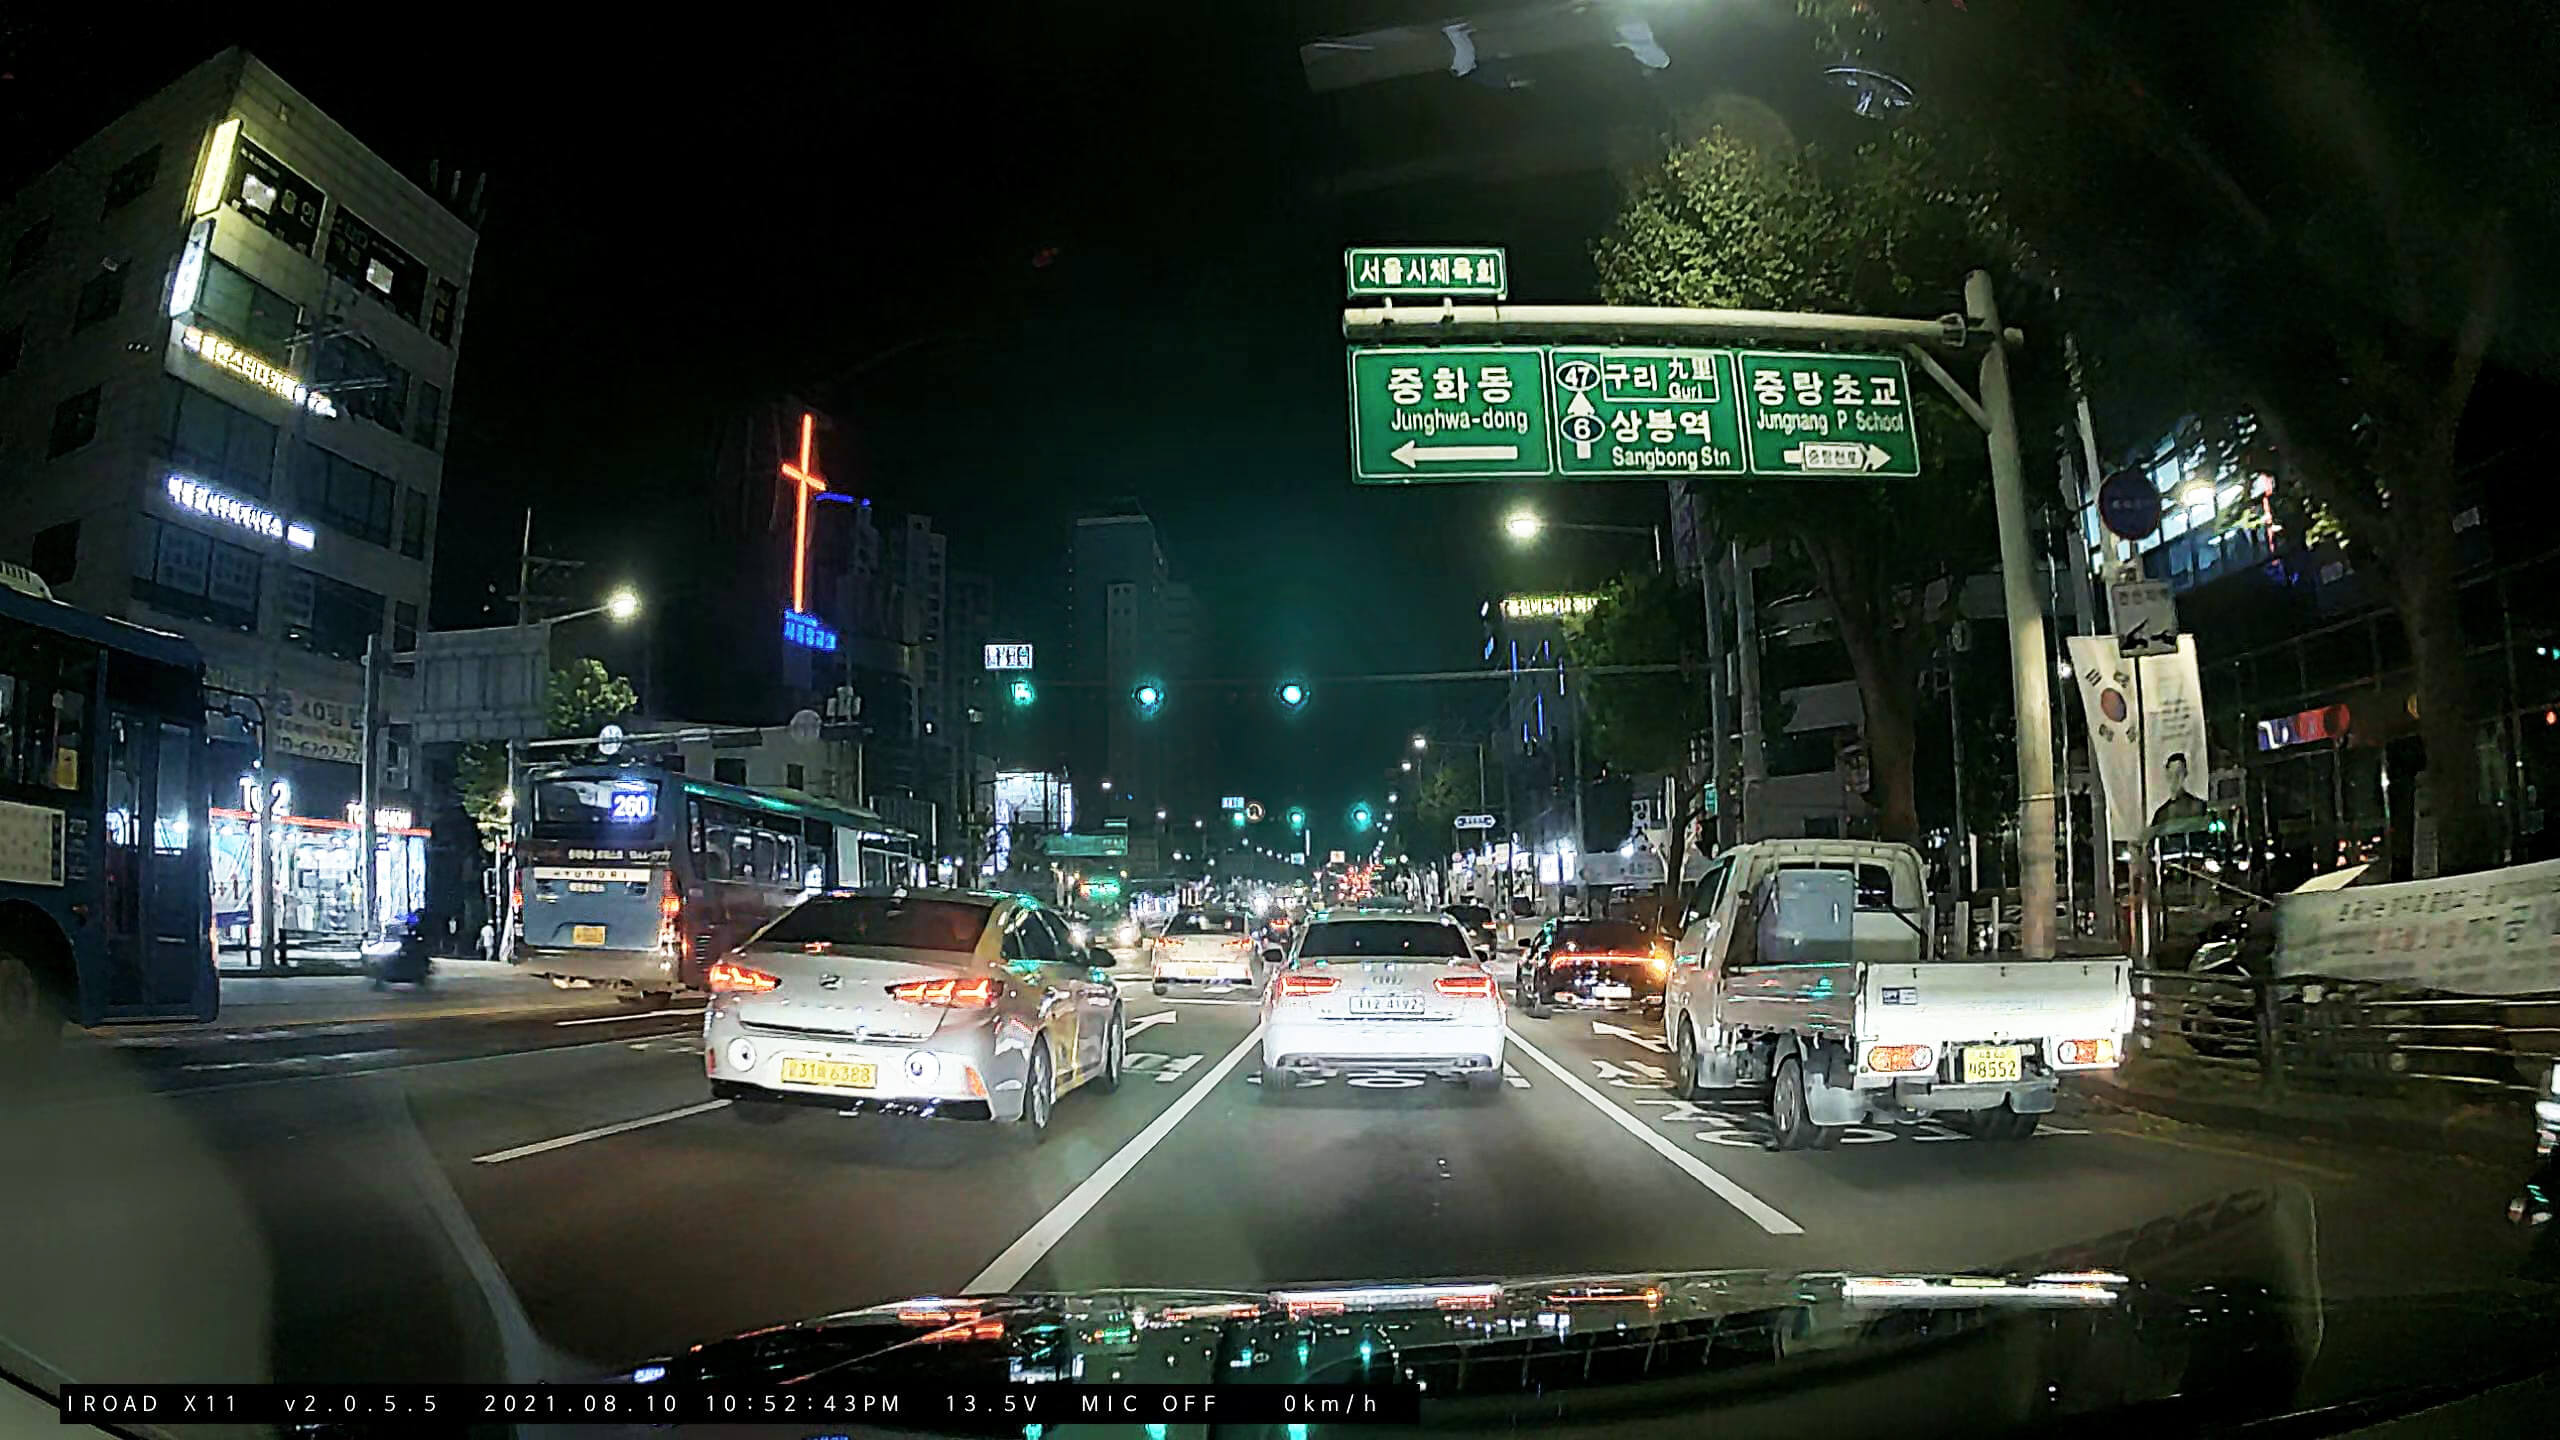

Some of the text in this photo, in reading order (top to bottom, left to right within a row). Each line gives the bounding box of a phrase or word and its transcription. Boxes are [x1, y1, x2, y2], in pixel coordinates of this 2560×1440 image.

[1359, 256, 1496, 286] 서울시체육회
[1388, 366, 1513, 405] 중화동
[1565, 367, 1591, 387] 47
[1606, 363, 1658, 391] 구리
[1669, 382, 1703, 400] Guri
[1753, 369, 1901, 406] 중랑초교
[1391, 406, 1529, 436] Junghwa-dong
[1574, 418, 1591, 439] 6
[1611, 409, 1712, 443] 상봉역
[1756, 407, 1904, 436] Jungnang P School
[1612, 446, 1731, 471] Sangbong Stn
[614, 795, 648, 817] 260
